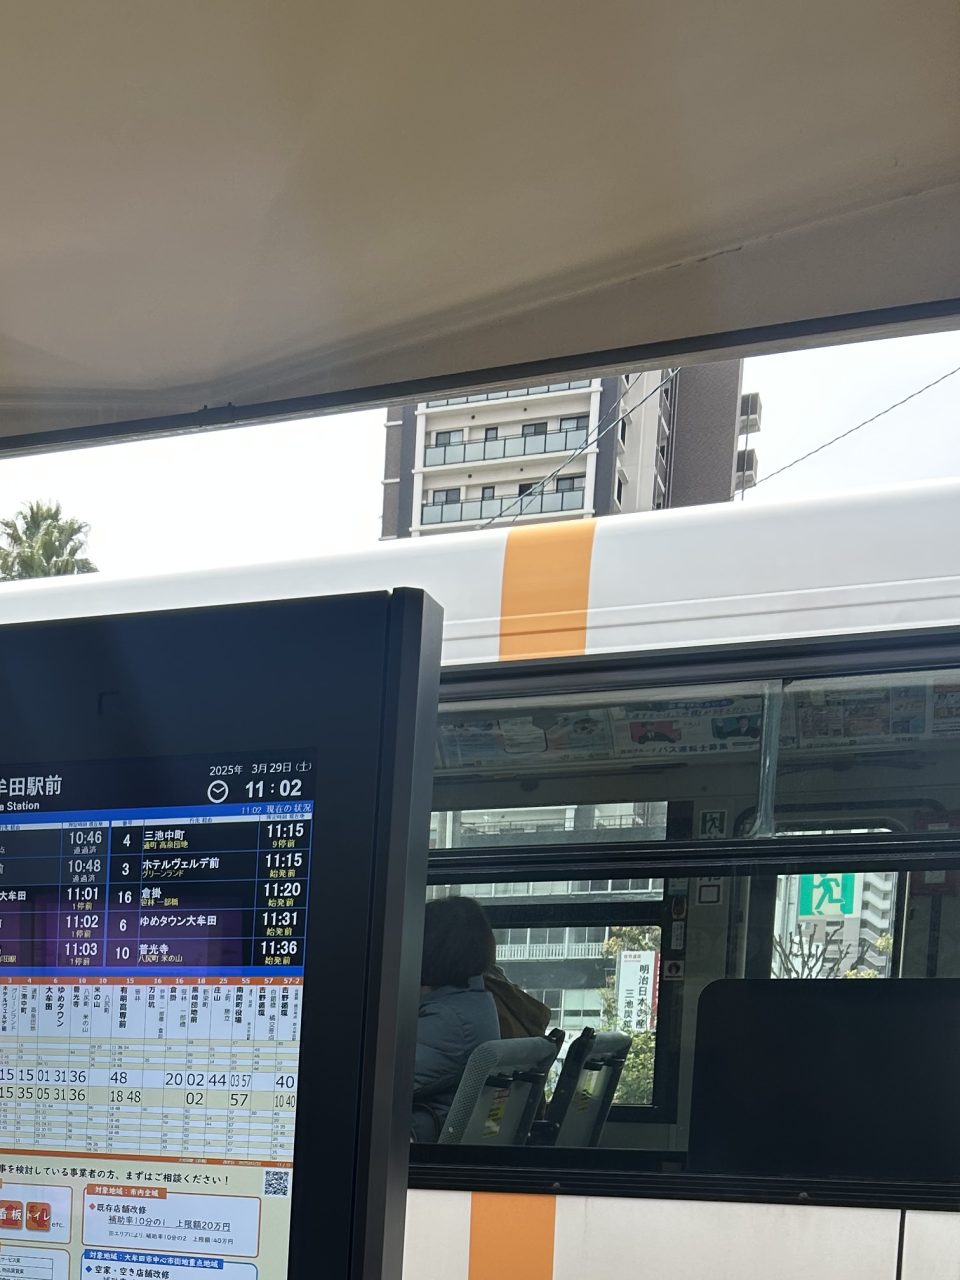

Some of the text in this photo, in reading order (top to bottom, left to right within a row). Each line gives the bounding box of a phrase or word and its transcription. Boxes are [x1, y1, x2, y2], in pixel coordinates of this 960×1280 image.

[210, 765, 243, 775] 2025年
[7, 802, 39, 810] Station
[267, 804, 311, 813] 現在の状況
[144, 830, 185, 841] 三池中町
[267, 824, 304, 838] 11:15
[70, 831, 102, 845] 10:46
[123, 834, 130, 847] 4
[68, 859, 101, 872] 10:48
[143, 858, 219, 870] ホテルヴェルデ前
[266, 853, 302, 867] 11:15
[122, 863, 129, 875] 3
[142, 870, 184, 878] グリーンランド
[270, 870, 296, 878] 始発前
[67, 888, 98, 900] 11:01
[142, 887, 161, 898] 倉掛
[264, 883, 301, 896] 11:20
[118, 891, 132, 903] 16
[268, 899, 294, 907] 始発前
[66, 915, 98, 928] 11:02
[120, 919, 126, 931] 6
[140, 916, 217, 926] ゆめタウン大牟田
[263, 912, 297, 926] 11:31
[65, 943, 97, 956] 11:03
[116, 947, 129, 959] 10
[139, 944, 169, 955] 普光寺
[261, 941, 297, 955] 11:36
[265, 957, 290, 965] 始発前
[45, 987, 53, 1011] 大牟田
[57, 987, 65, 1027] ゆめタウン
[0, 1069, 14, 1080] 15
[19, 1070, 33, 1081] 15
[38, 1070, 49, 1081] 01
[54, 1071, 66, 1082] 31
[69, 1071, 86, 1082] 36
[111, 1072, 127, 1083] 48
[166, 1073, 182, 1085] 20
[187, 1074, 204, 1086] 02
[209, 1075, 226, 1086] 44
[231, 1075, 239, 1087] 03
[242, 1075, 251, 1087] 57
[276, 1076, 294, 1088] 40
[0, 1087, 13, 1098] 15
[18, 1087, 33, 1099] 35
[37, 1088, 49, 1099] 05
[54, 1089, 66, 1100] 31
[69, 1089, 85, 1100] 36
[111, 1091, 123, 1102] 18
[127, 1091, 140, 1102] 48
[187, 1093, 203, 1105] 02
[231, 1094, 248, 1106] 57
[275, 1096, 283, 1107] 10
[286, 1096, 295, 1107] 40
[97, 1204, 147, 1214] 既存店舗改修
[27, 1211, 50, 1221] トイレ
[176, 1219, 231, 1232] 上限額20万円
